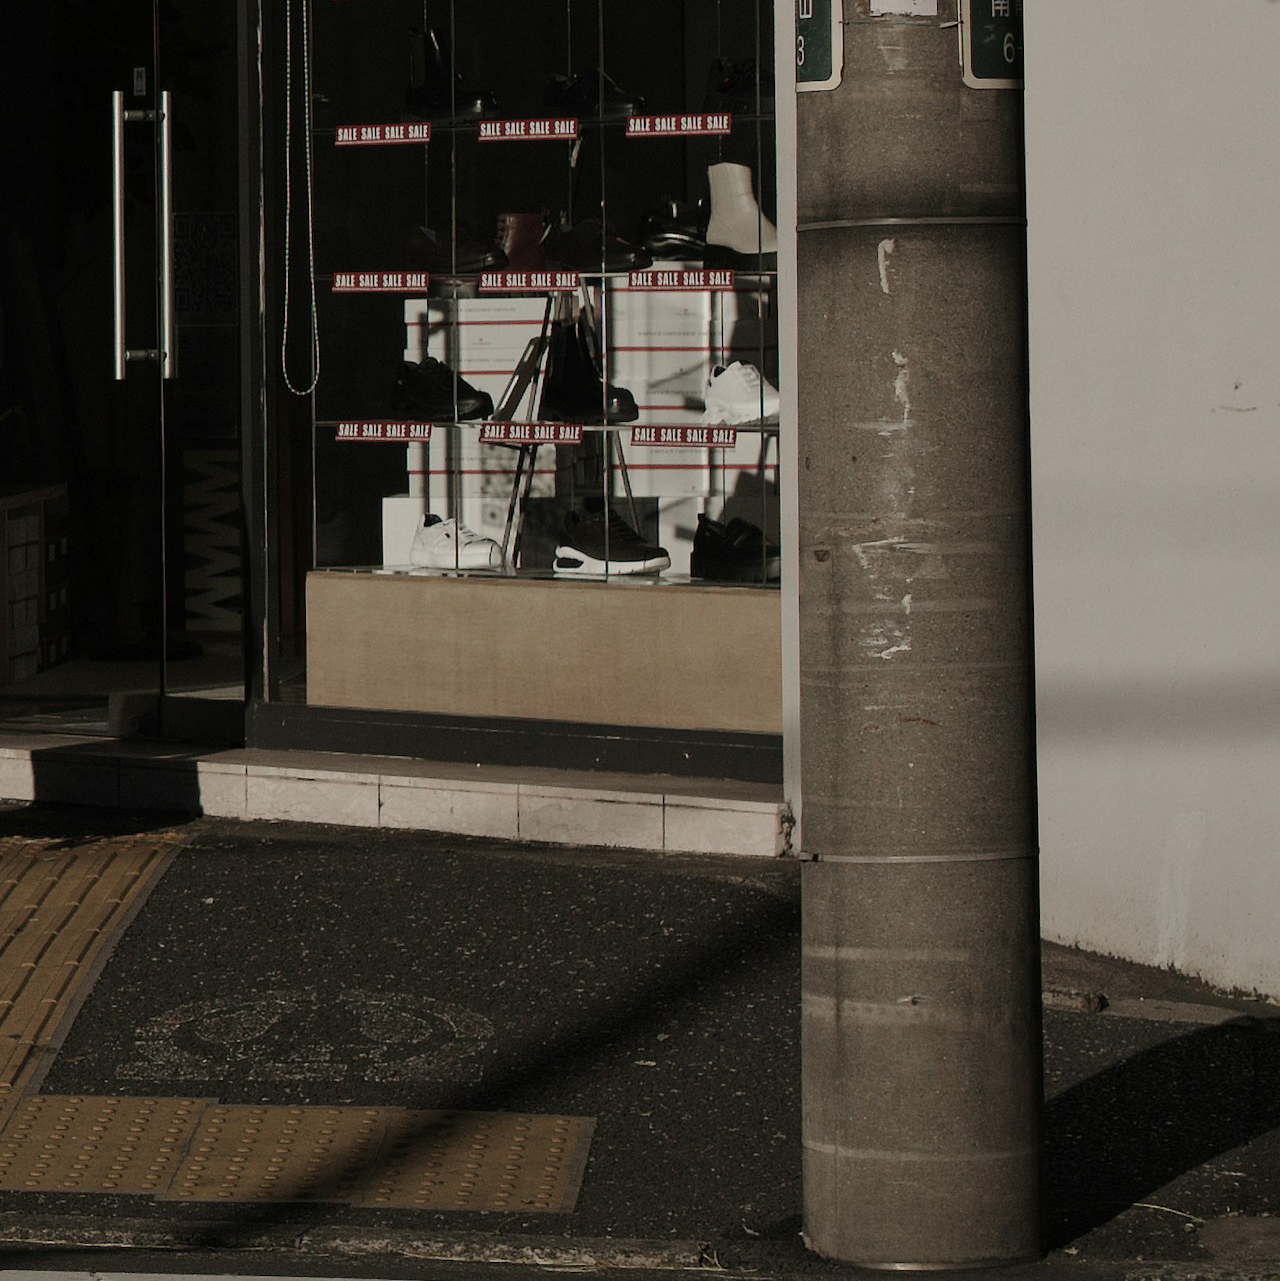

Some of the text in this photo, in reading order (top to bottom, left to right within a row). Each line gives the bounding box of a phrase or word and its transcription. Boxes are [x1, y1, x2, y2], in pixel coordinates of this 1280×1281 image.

[480, 119, 573, 136] SALE SALE SALE SALE
[629, 115, 727, 131] SALE SALE SALE SALE
[338, 124, 427, 140] SALE SALE SALE SALE
[336, 273, 425, 287] SALE SALE SALE SALE
[481, 273, 574, 287] SALE SALE SALE SALE
[631, 270, 729, 286] SALE SALE SALE SALE
[339, 423, 428, 437] SALE SALE SALE SALE
[485, 423, 578, 440] SALE SALE SALE SALE
[635, 427, 733, 443] SALE SALE SALE SALE
